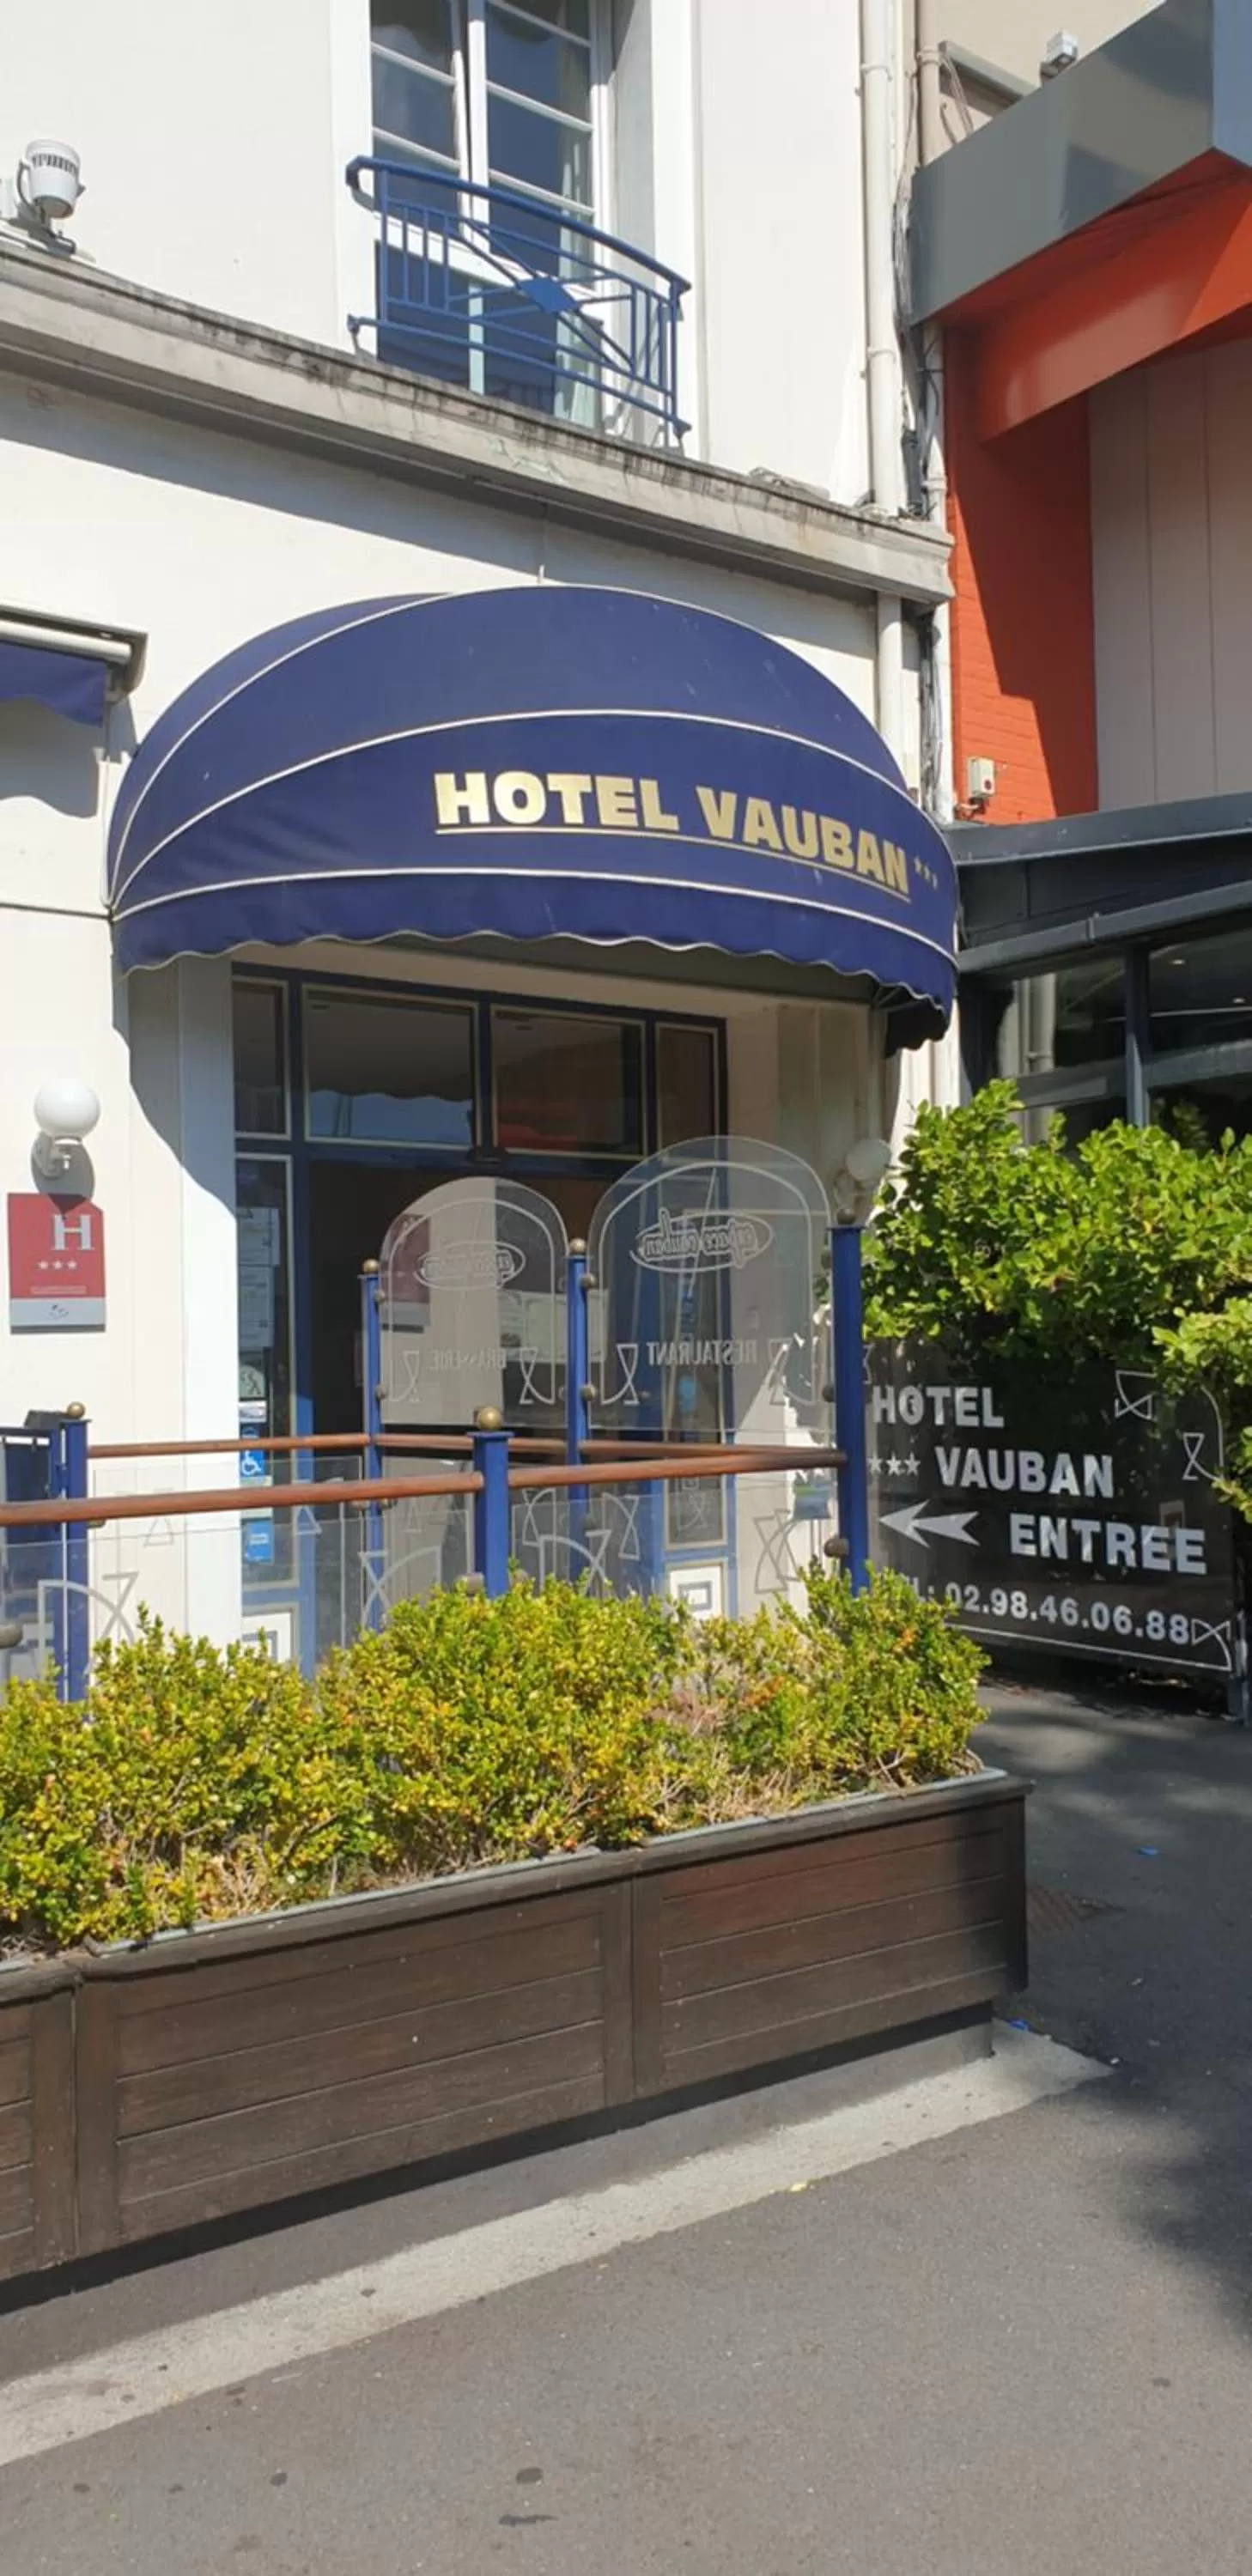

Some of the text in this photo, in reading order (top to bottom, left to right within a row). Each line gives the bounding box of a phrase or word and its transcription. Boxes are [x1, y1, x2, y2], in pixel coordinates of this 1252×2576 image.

[434, 770, 910, 895] HOTEL VAUBAN
[52, 1214, 95, 1251] H
[872, 1385, 1005, 1429] HOTEL
[934, 1446, 1115, 1498] VAUBAN
[1010, 1513, 1207, 1575] ENTREE
[945, 1582, 1190, 1644] 02.98.46.06.88
